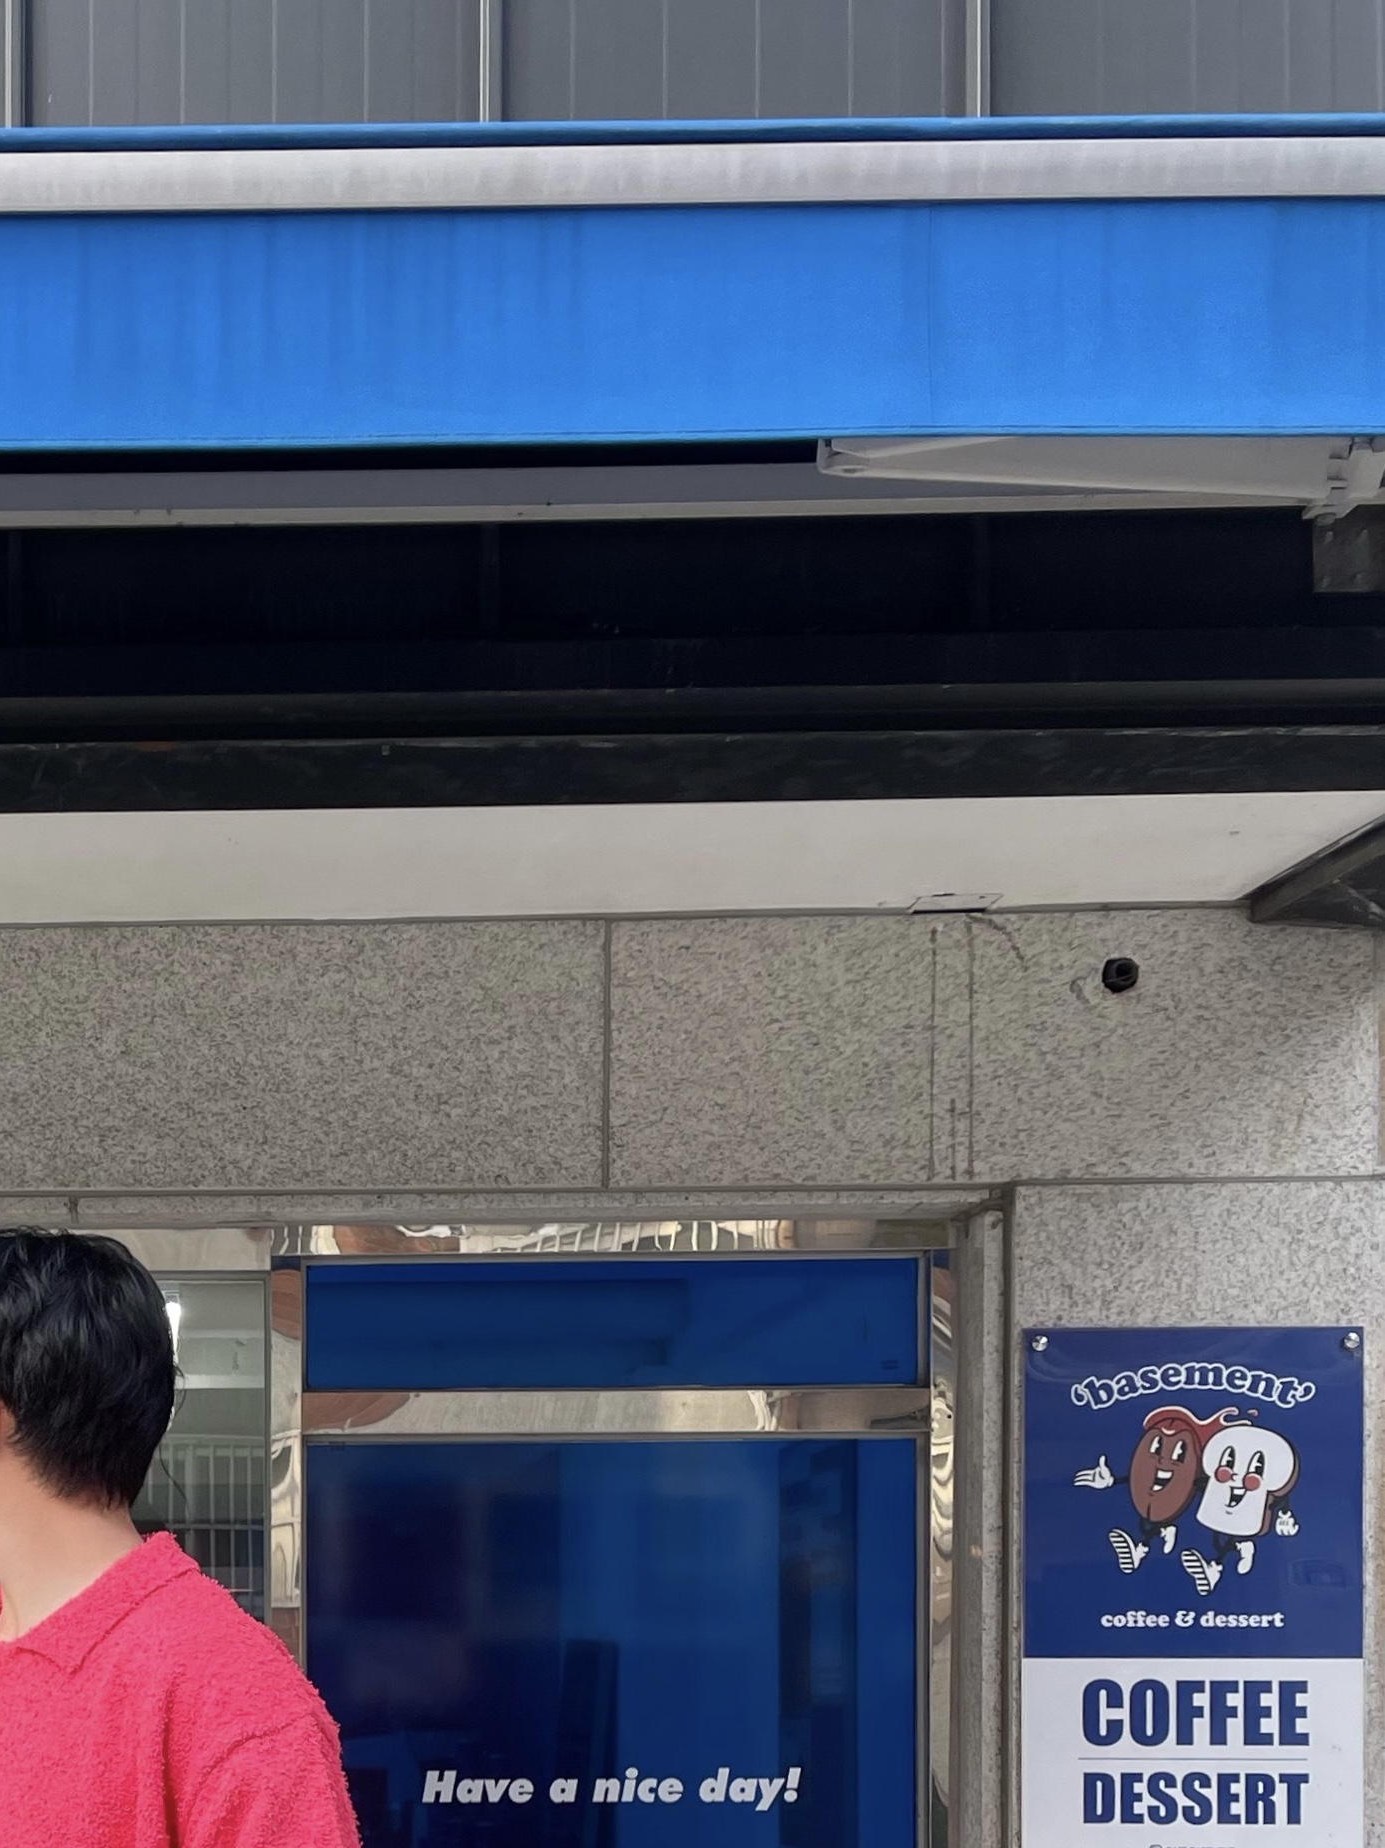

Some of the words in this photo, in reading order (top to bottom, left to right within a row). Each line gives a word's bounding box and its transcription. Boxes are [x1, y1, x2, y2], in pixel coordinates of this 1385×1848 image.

[1100, 1610, 1170, 1628] coffee
[1175, 1610, 1196, 1628] &
[1199, 1610, 1285, 1628] dessert
[1082, 1678, 1310, 1746] COFFEE
[422, 1769, 535, 1804] Have
[549, 1776, 578, 1804] a
[592, 1767, 684, 1804] nice
[699, 1767, 802, 1812] day!
[1082, 1771, 1310, 1825] DESSERT
